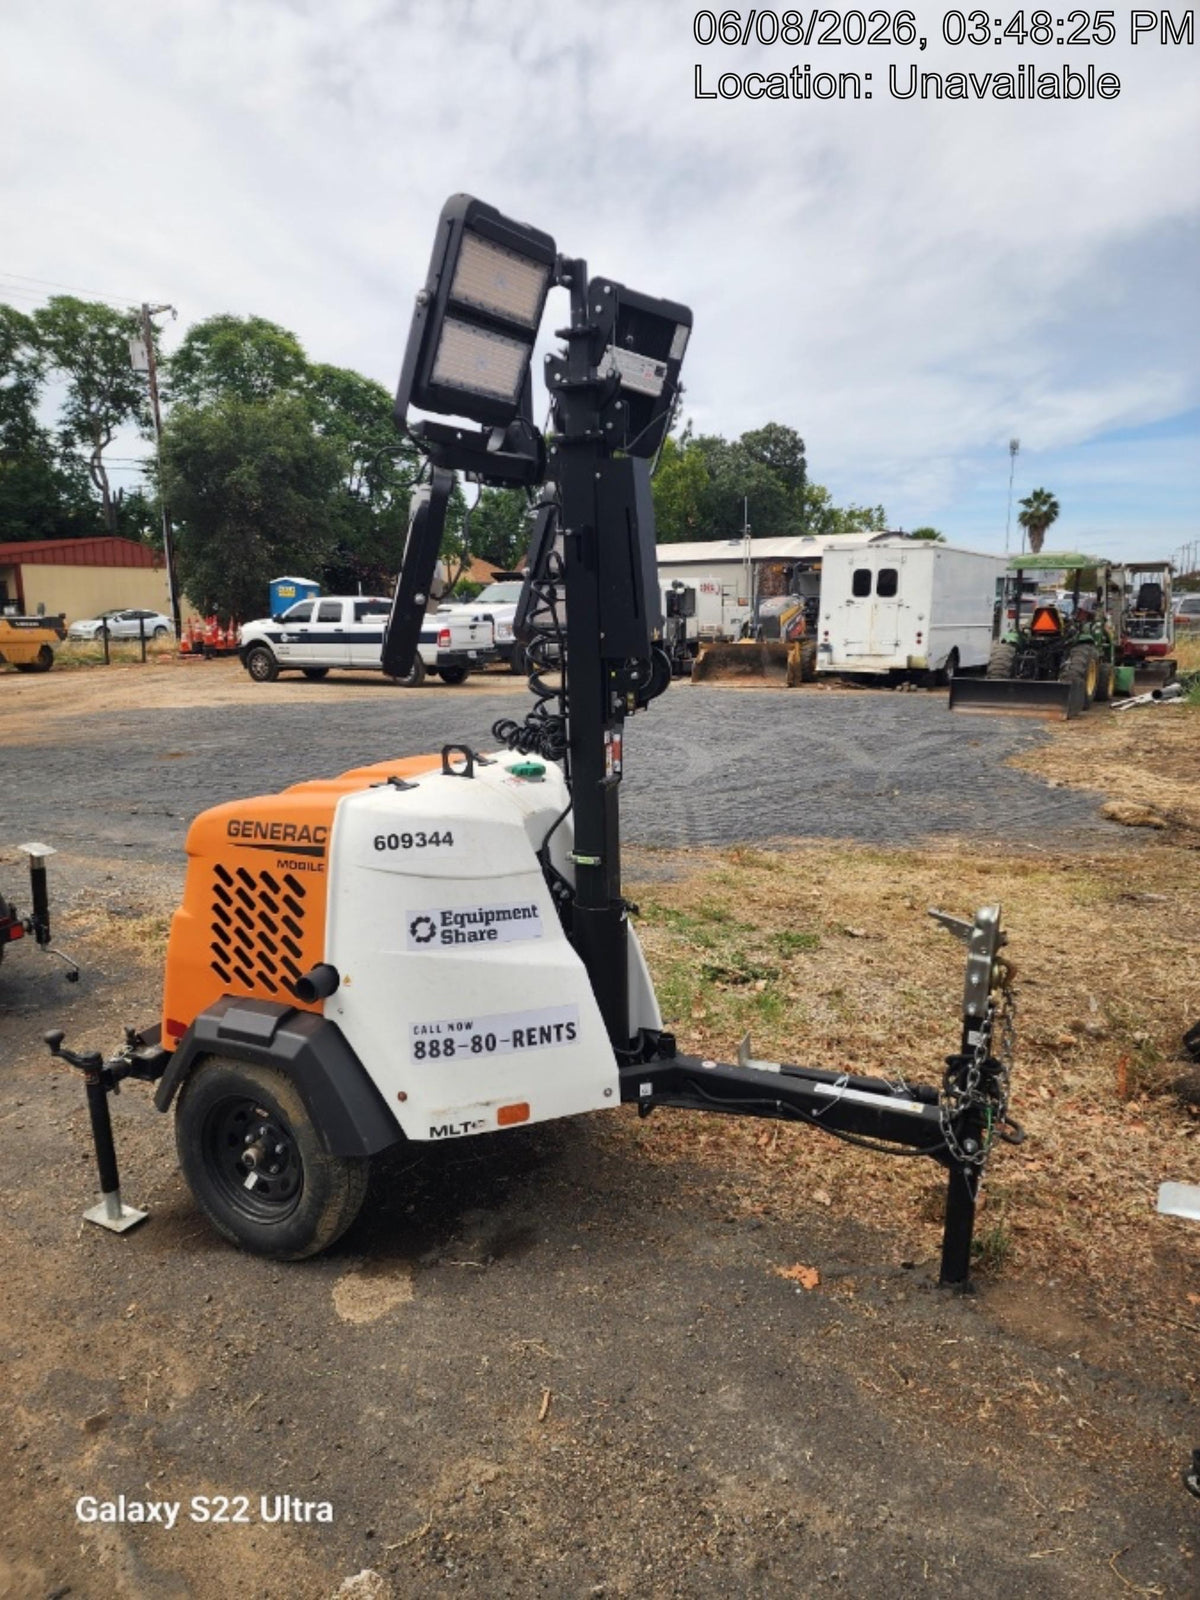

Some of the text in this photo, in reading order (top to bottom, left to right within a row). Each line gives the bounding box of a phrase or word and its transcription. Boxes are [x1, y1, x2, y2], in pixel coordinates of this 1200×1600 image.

[227, 819, 327, 843] GENERAC
[373, 831, 454, 851] 609344
[277, 860, 325, 872] MOBILE
[440, 904, 539, 928] Equipment
[440, 928, 498, 944] Share
[413, 1021, 474, 1035] CALL NOW
[413, 1022, 577, 1060] 888-80-RENTS
